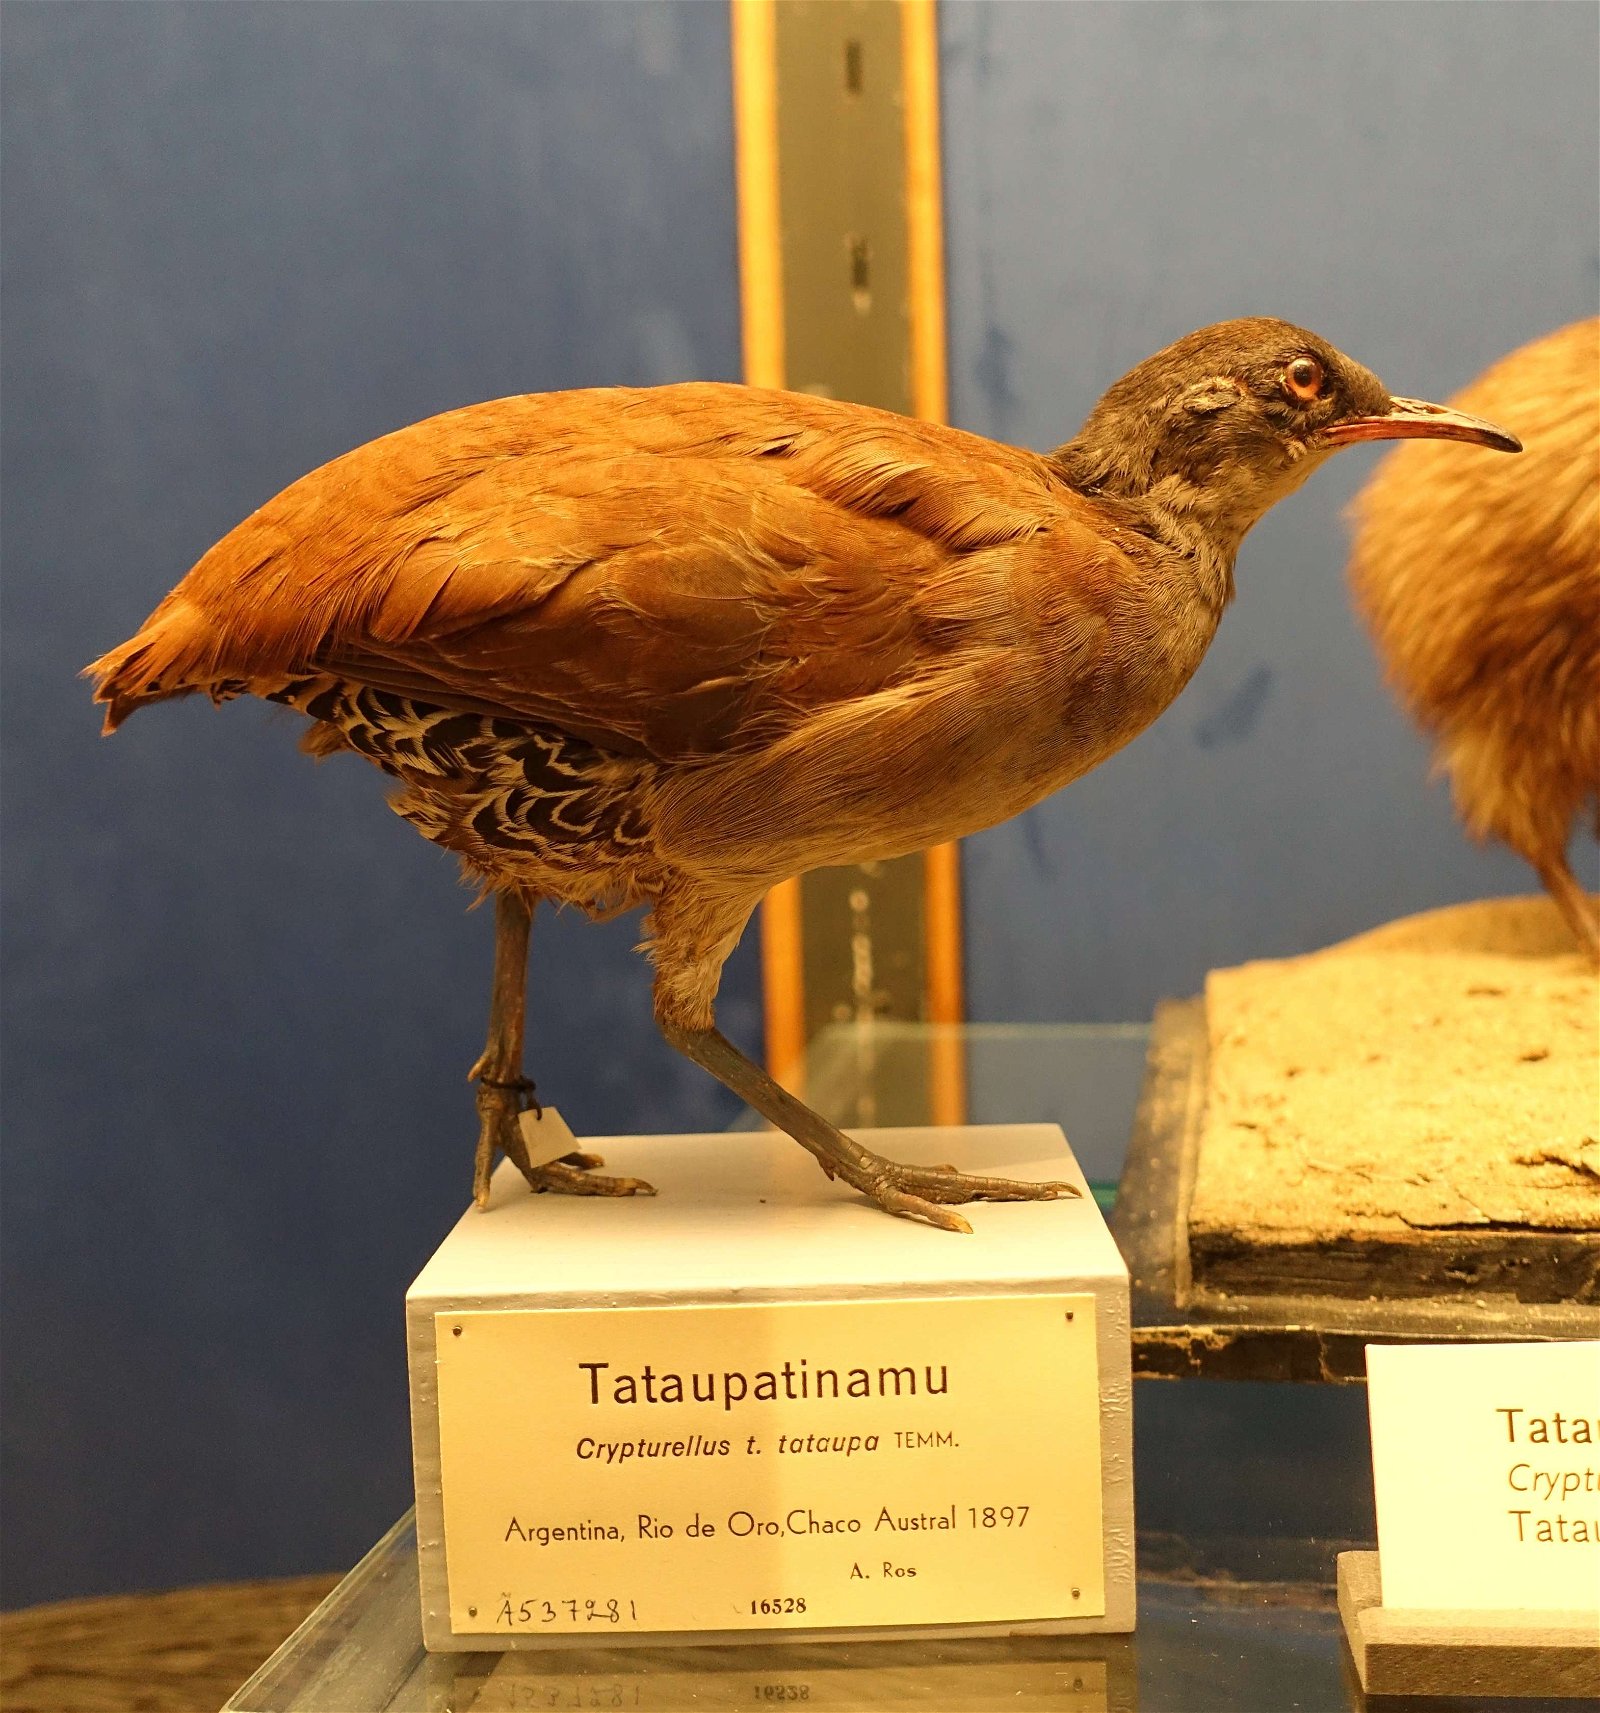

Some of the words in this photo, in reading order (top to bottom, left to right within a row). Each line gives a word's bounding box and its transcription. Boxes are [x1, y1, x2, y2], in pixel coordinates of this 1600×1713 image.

[578, 1358, 948, 1411] Tataupatinamu
[1495, 1408, 1600, 1444] Tata
[576, 1434, 731, 1464] Crypturellus
[746, 1434, 762, 1455] t.
[778, 1433, 880, 1458] tataupa
[893, 1431, 960, 1449] TEMM.
[1508, 1463, 1600, 1502] Crypt
[504, 1516, 625, 1546] Argentina,
[637, 1514, 674, 1540] Rio
[685, 1512, 716, 1538] de
[873, 1503, 956, 1532] Austral
[967, 1505, 1031, 1529] 1897
[849, 1561, 871, 1580] A.
[882, 1561, 918, 1579] Ros
[750, 1597, 807, 1615] 16528
